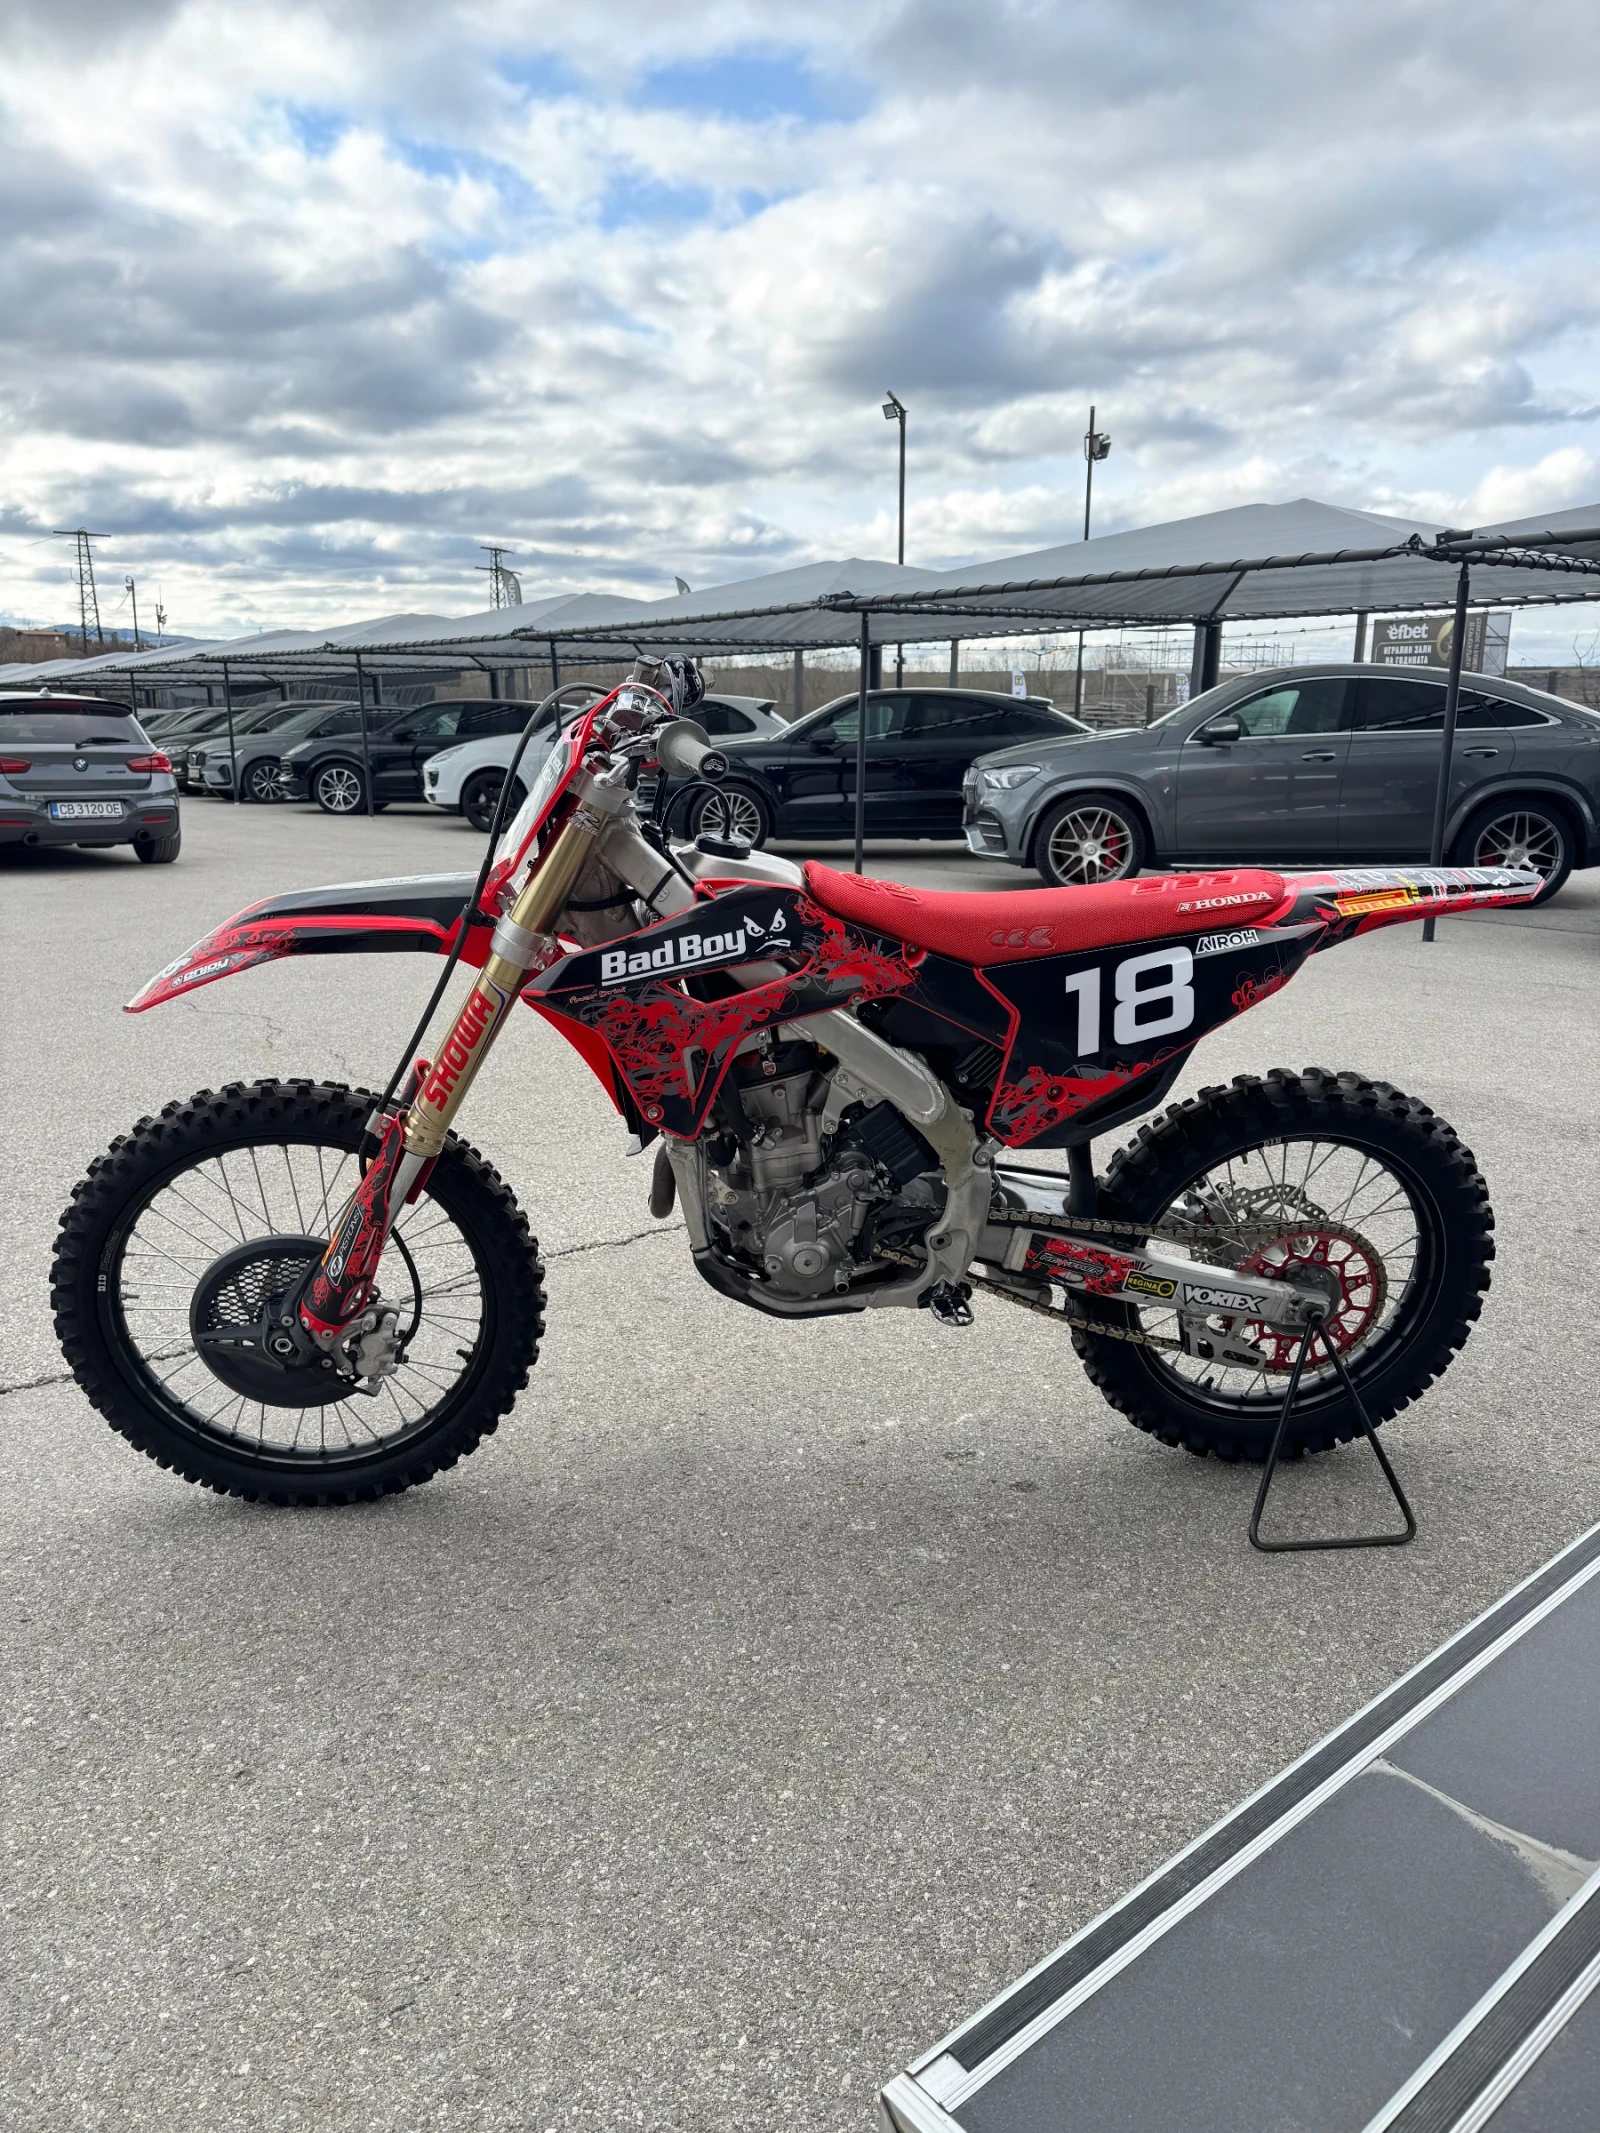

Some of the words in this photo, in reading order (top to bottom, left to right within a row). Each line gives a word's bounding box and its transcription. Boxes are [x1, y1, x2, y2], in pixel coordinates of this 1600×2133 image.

[1387, 623, 1429, 640] efbet
[59, 804, 75, 815] CB
[77, 804, 104, 815] 3120
[105, 803, 121, 814] OE
[1195, 891, 1274, 911] HONDA
[1336, 891, 1411, 915] PIRELLI
[1195, 929, 1260, 955] AIROH
[1065, 946, 1195, 1058] 18
[424, 987, 496, 1113] SHOWA
[1127, 1276, 1159, 1291] REGINA
[1183, 1283, 1268, 1314] VORTEX
